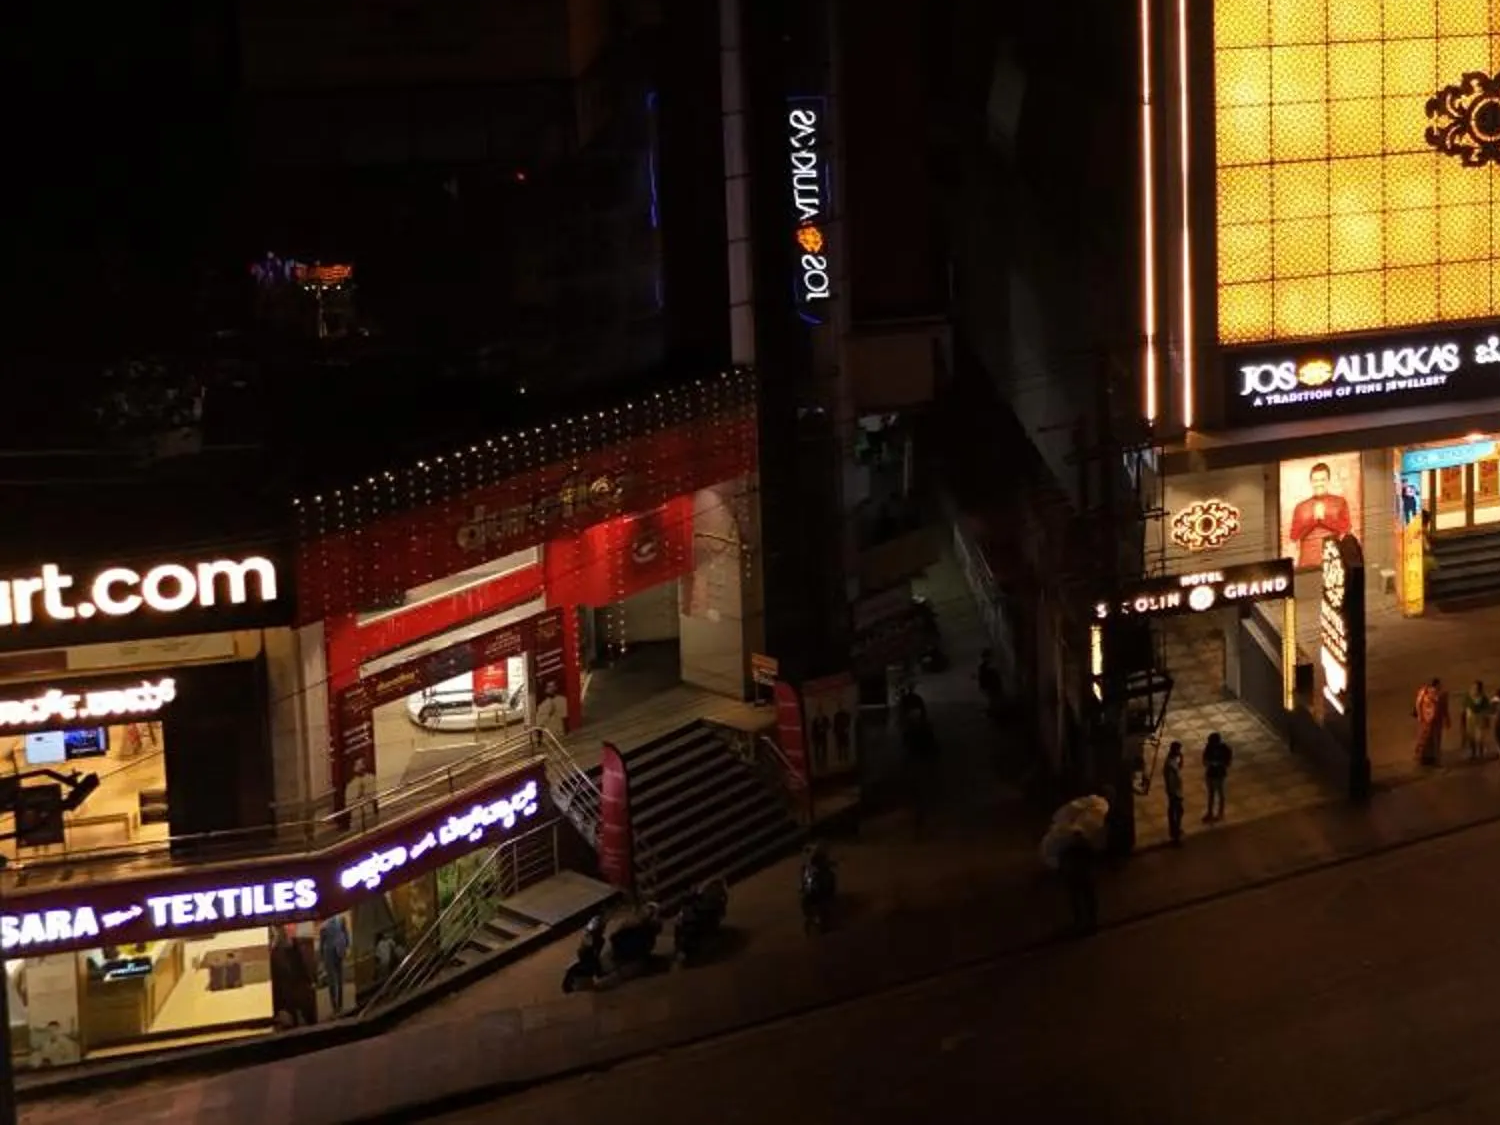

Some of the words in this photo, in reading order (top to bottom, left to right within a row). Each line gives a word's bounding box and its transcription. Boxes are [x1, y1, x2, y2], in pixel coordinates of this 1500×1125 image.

[1240, 361, 1298, 395] JOS
[1332, 342, 1460, 382] ALUKKAS
[1253, 396, 1263, 407] A
[1267, 389, 1332, 406] TRADITION
[1336, 386, 1350, 397] OF
[1355, 383, 1382, 395] FINE
[1096, 592, 1181, 618] SOLIN
[1224, 576, 1287, 599] GRAND
[1180, 571, 1224, 587] HOTEL
[0, 906, 99, 948] SARA
[147, 878, 318, 927] TEXTILES
